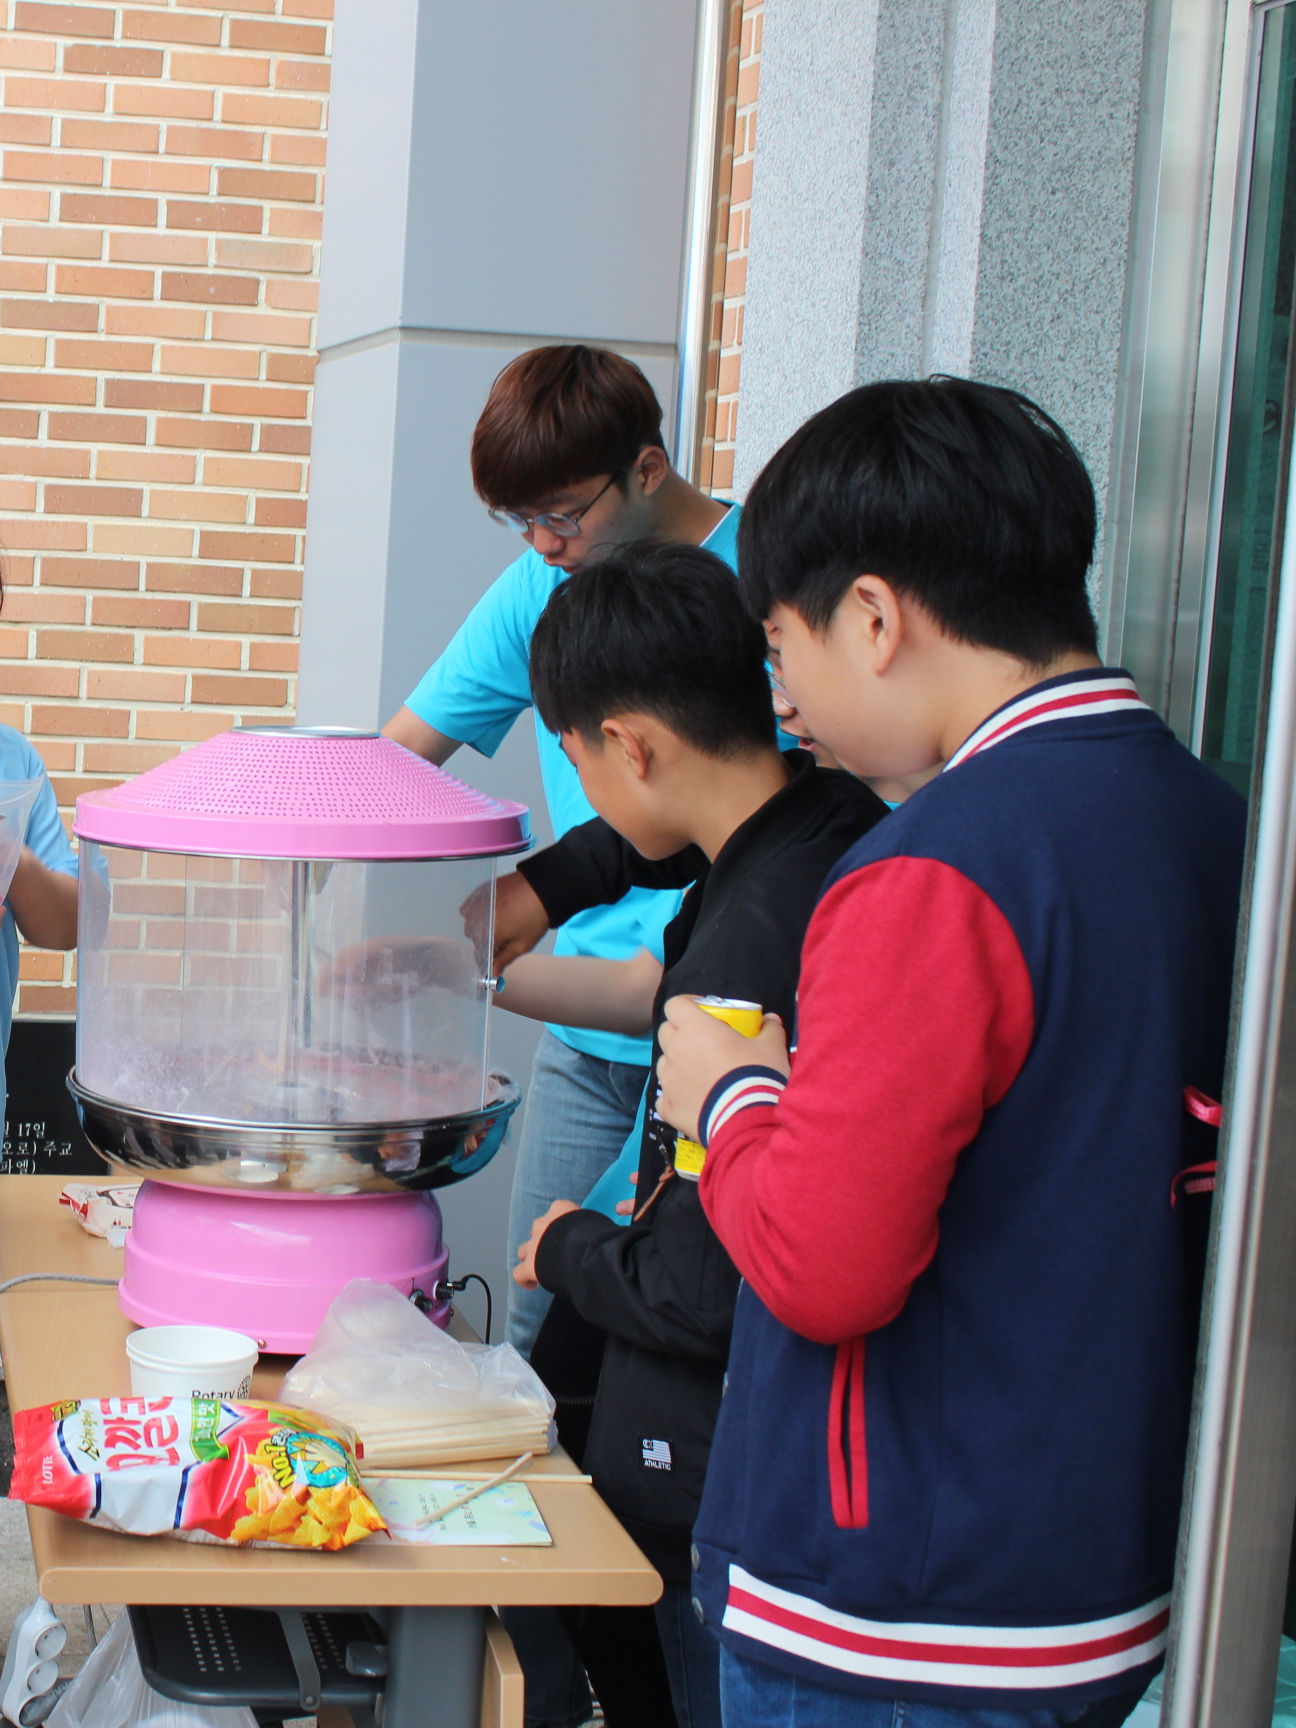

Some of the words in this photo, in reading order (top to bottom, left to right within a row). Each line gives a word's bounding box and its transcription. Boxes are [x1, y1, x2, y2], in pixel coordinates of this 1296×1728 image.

[44, 1140, 73, 1157] 주교
[42, 1455, 53, 1484] LOTTE
[644, 1459, 671, 1471] ATHLETIC
